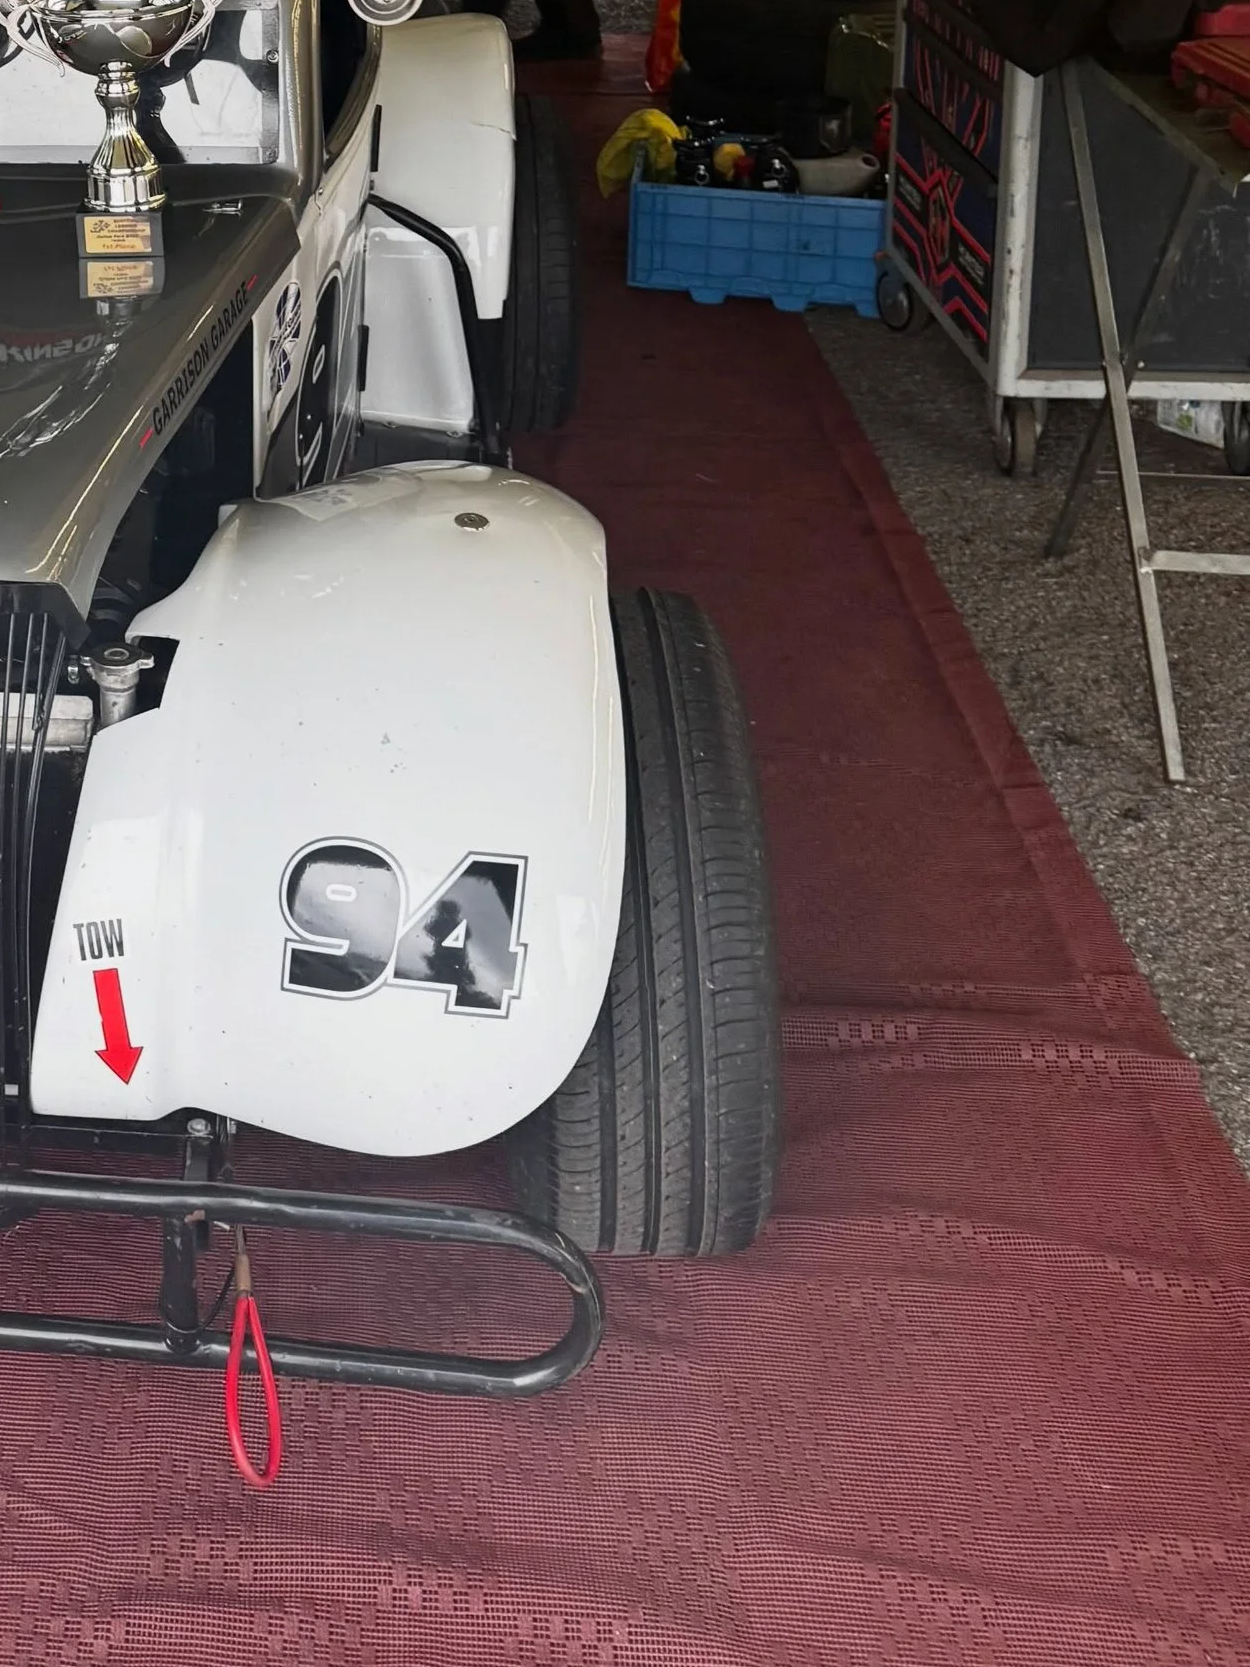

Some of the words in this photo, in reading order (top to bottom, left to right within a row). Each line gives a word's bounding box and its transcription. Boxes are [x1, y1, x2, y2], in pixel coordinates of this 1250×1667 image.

[152, 341, 211, 435] GARRISON
[210, 281, 249, 352] GARAGE
[72, 919, 125, 962] TOW
[279, 836, 529, 1019] 94
